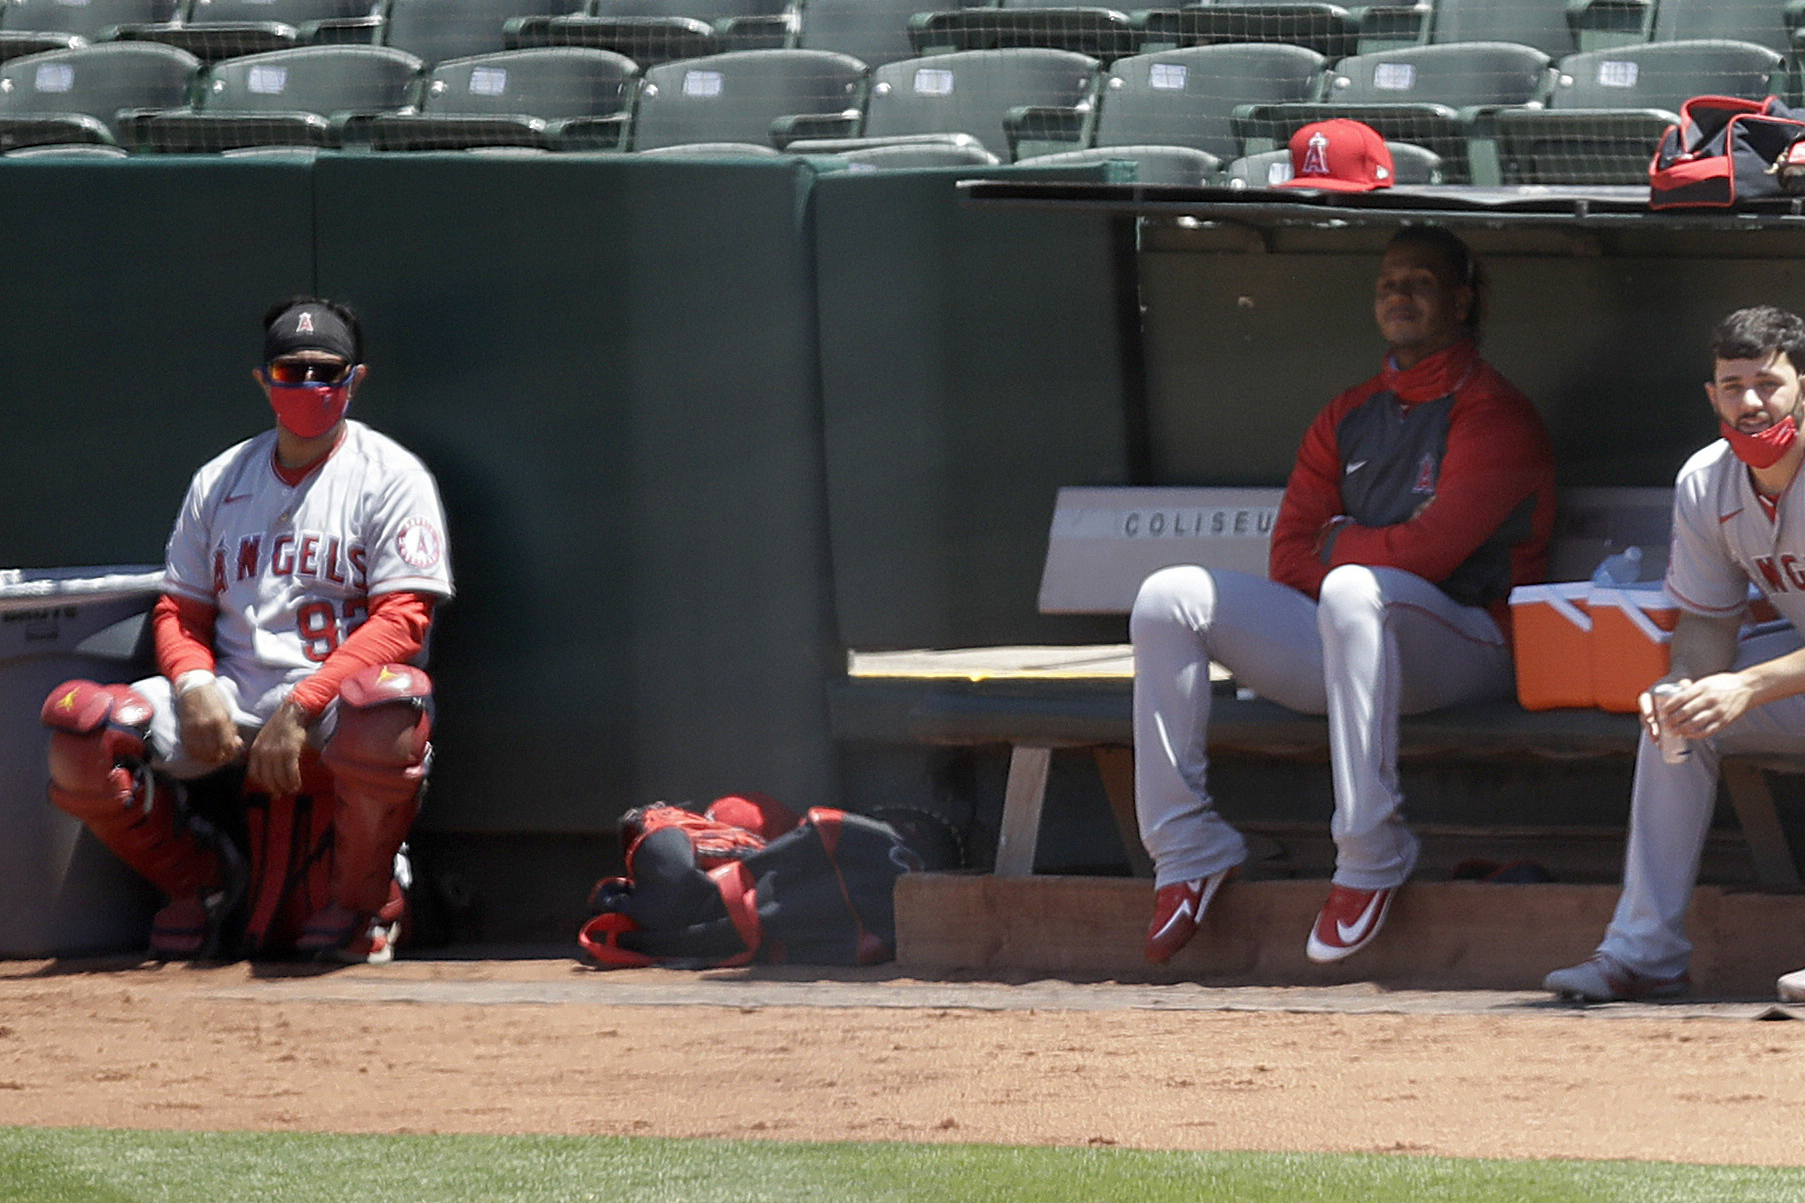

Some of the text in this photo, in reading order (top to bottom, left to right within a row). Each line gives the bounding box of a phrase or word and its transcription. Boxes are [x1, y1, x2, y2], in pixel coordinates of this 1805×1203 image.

[1302, 131, 1330, 174] A
[296, 311, 315, 333] A
[211, 531, 367, 596] ANGELS
